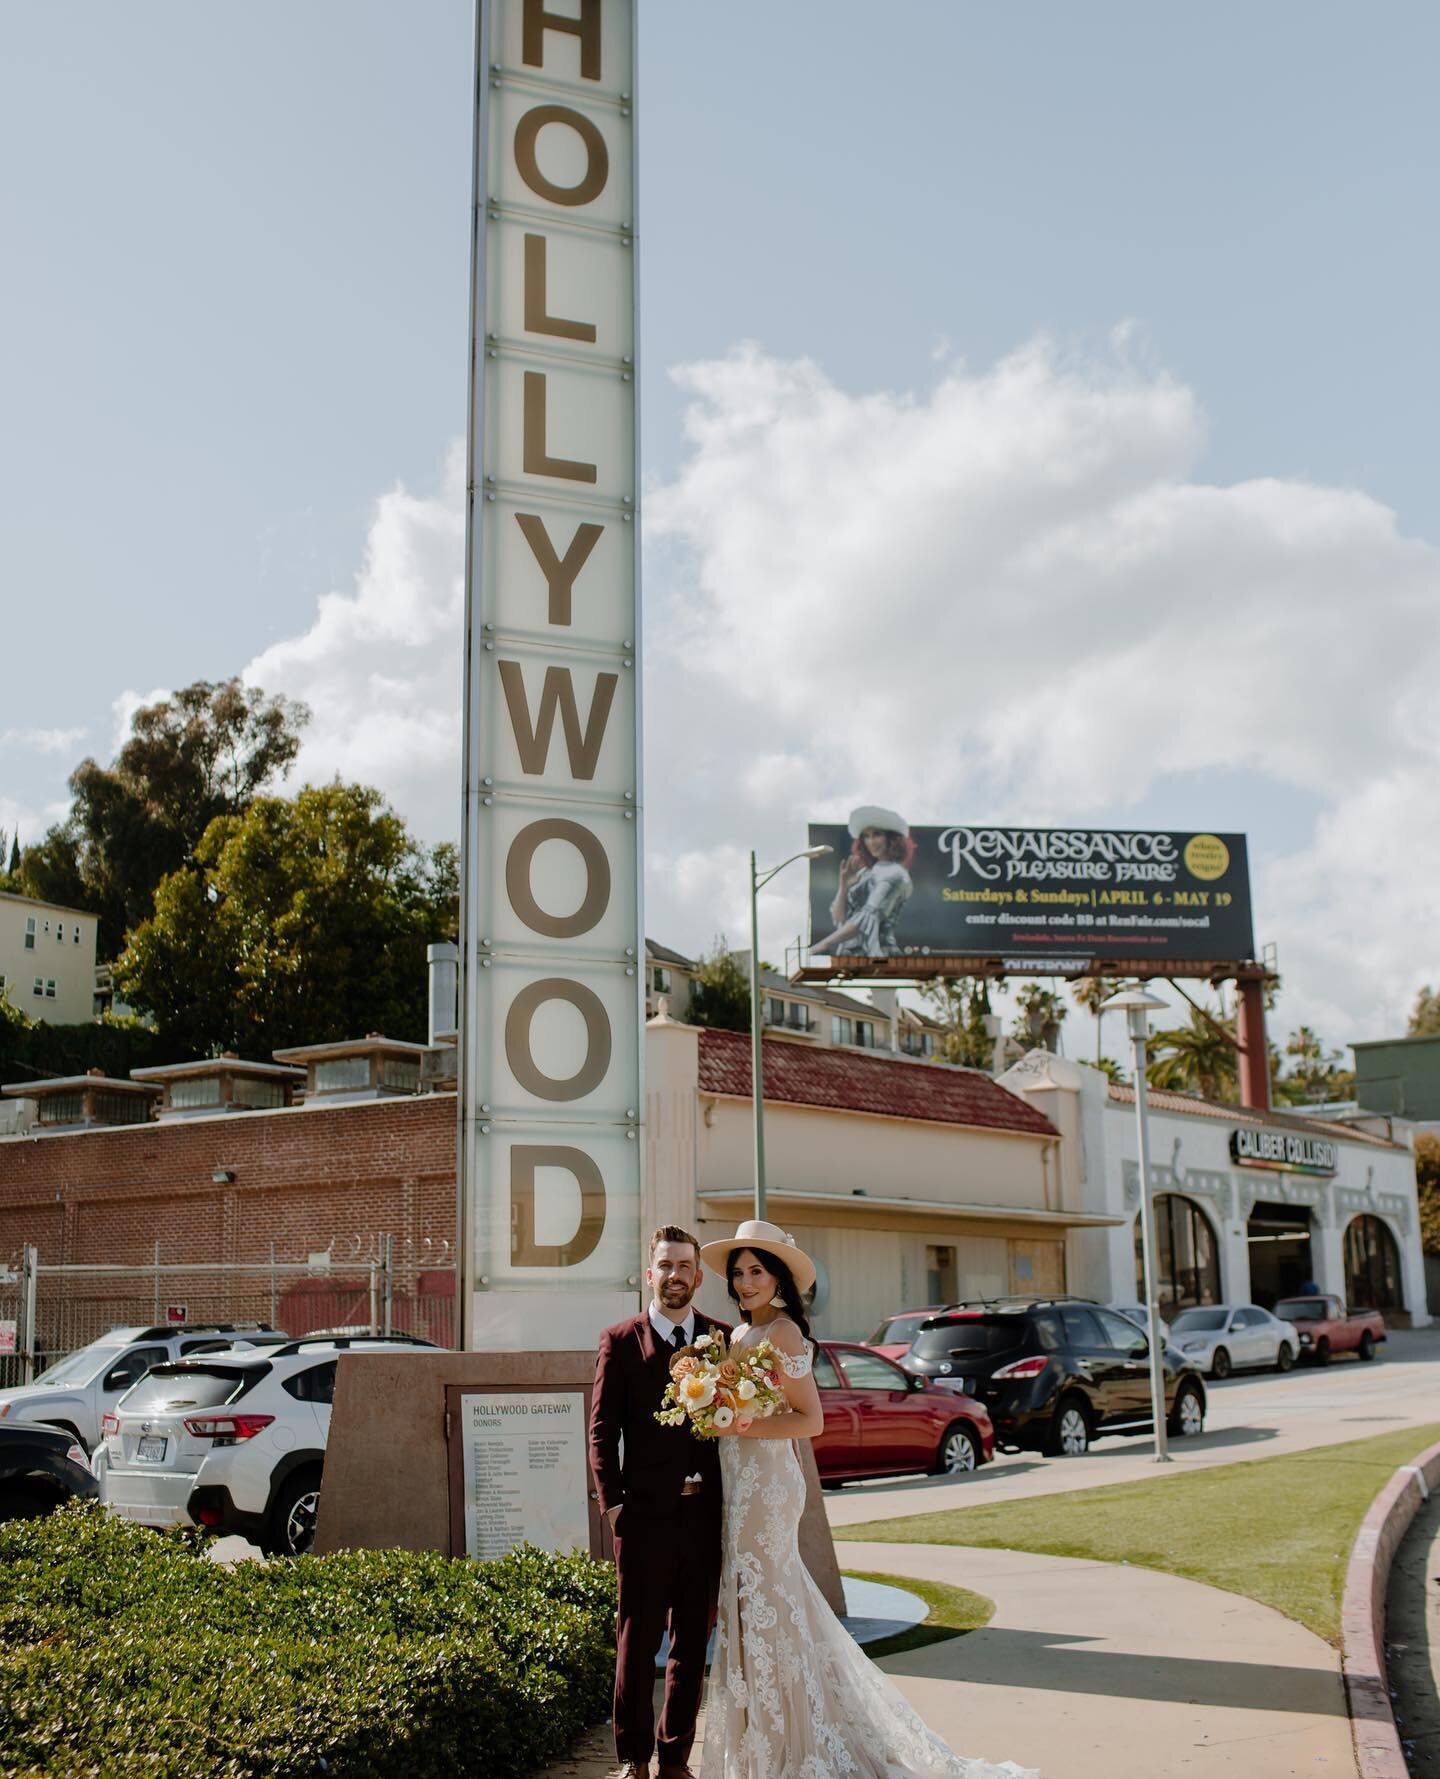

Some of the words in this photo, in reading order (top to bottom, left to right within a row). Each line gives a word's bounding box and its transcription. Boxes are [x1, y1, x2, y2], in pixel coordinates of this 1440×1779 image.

[498, 0, 618, 1267] HOLLYWOOD
[938, 828, 1178, 880] RENAISSANCE
[1006, 860, 1112, 881] PLEASURE
[943, 888, 1013, 906] Saturdays
[1015, 888, 1028, 903] &
[1030, 889, 1089, 907] Sundays
[1100, 890, 1149, 905] APRIL
[1153, 891, 1163, 905] 6
[1173, 891, 1210, 906] MAY
[1215, 892, 1232, 906] 19
[965, 914, 996, 925] enter
[998, 913, 1047, 925] discount
[1048, 913, 1075, 926] code
[1076, 914, 1094, 926] BB
[1095, 915, 1107, 926] at
[1237, 1129, 1286, 1161] CALIBER
[473, 1405, 528, 1415] HOLLYWOOD
[531, 1403, 571, 1415] GATEWAY
[473, 1419, 502, 1428] DONORS
